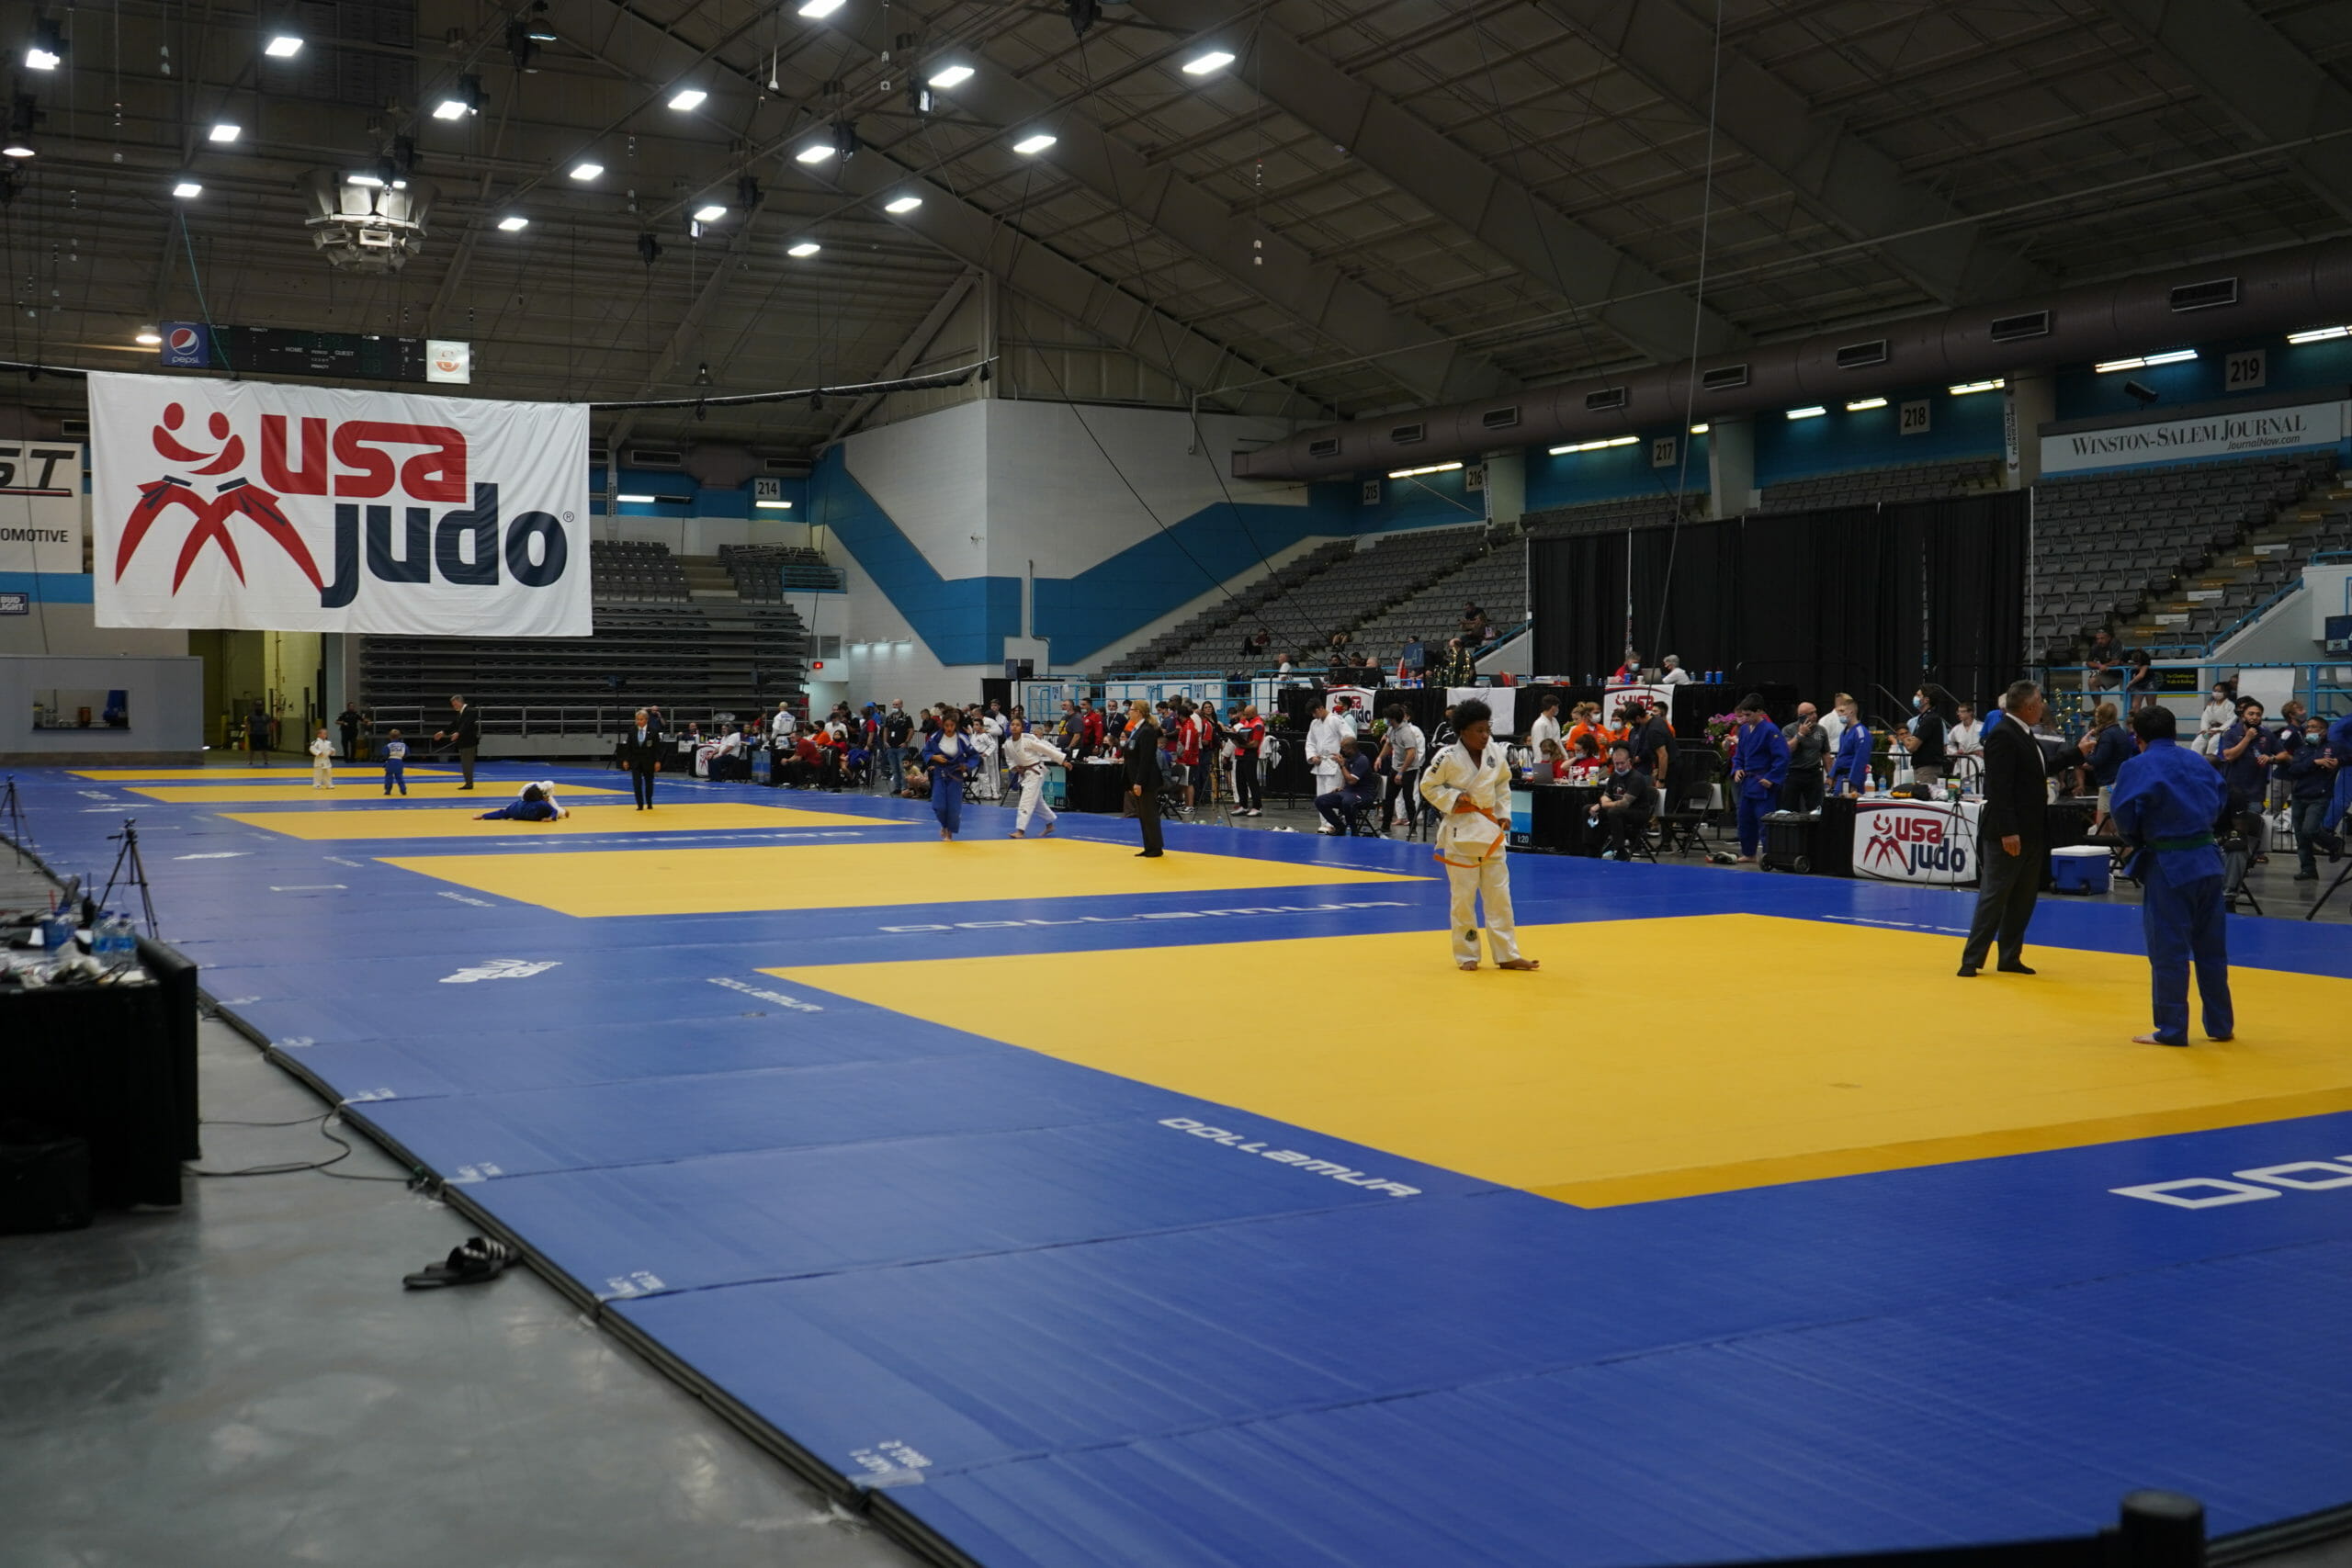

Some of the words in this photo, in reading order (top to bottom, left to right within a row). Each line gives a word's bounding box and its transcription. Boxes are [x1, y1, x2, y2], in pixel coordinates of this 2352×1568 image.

[171, 355, 199, 364] pepsi
[2230, 357, 2260, 383] 219
[1905, 406, 1927, 427] 218
[2072, 424, 2216, 457] WINSTON-SALEM
[2221, 414, 2307, 441] JOURNAL
[2227, 434, 2301, 451] JournalNow.com
[1656, 443, 1673, 461] 217
[1468, 470, 1483, 486] 216
[758, 481, 778, 495] 214
[1365, 486, 1378, 500] 215
[321, 482, 568, 607] judo
[1907, 837, 1966, 875] judo
[2108, 1155, 2352, 1210] DO
